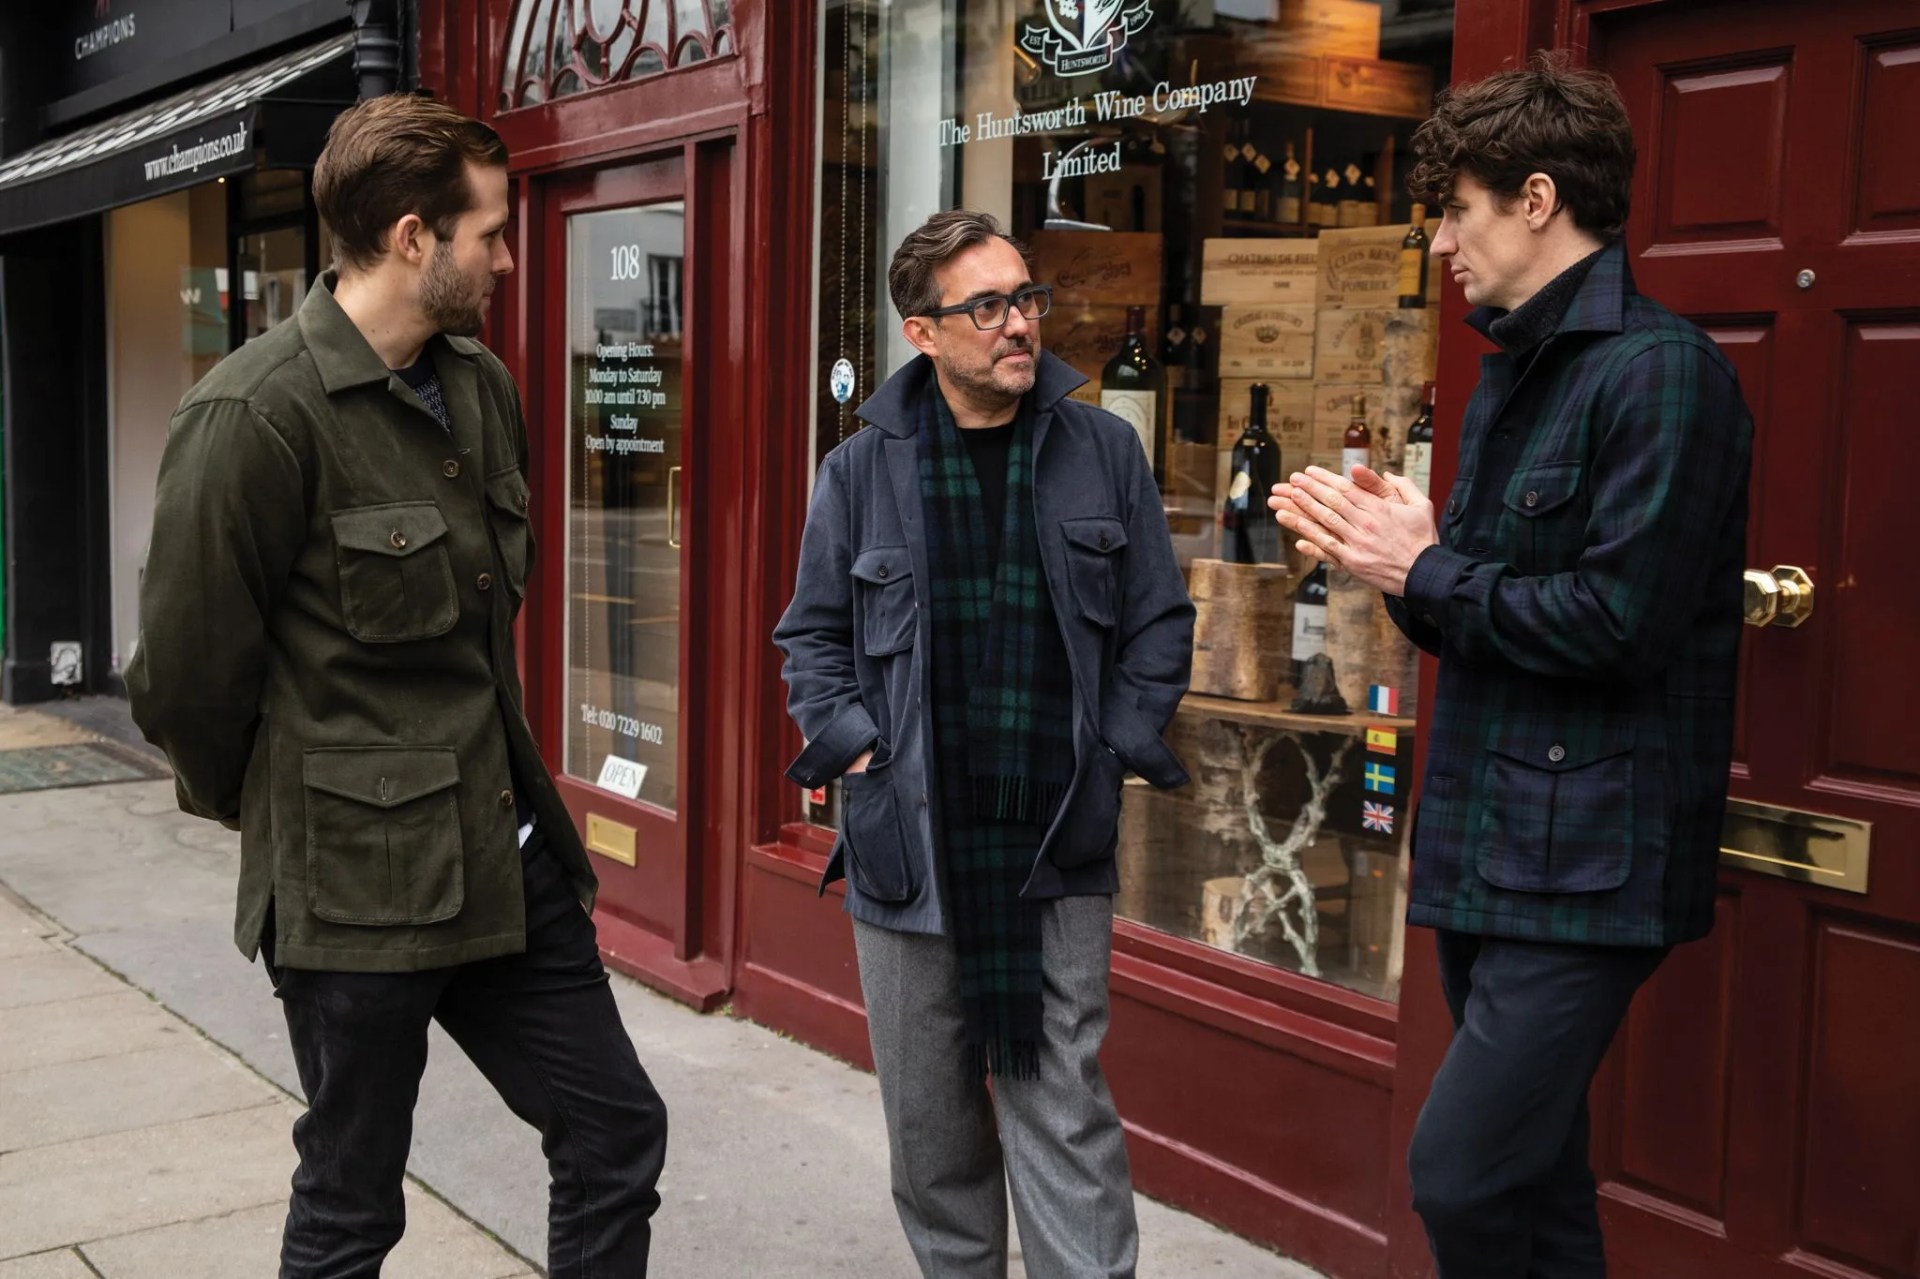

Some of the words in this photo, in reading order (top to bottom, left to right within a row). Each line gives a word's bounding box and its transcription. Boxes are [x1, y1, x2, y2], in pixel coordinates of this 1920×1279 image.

[75, 12, 135, 60] CHAMPIONS
[938, 117, 970, 147] The
[976, 97, 1086, 142] Huntsworth
[1094, 90, 1147, 123] Wine
[1152, 75, 1257, 114] Company
[144, 120, 249, 181] www.champions.co.uk
[1042, 142, 1122, 181] Limited
[610, 244, 640, 280] 108
[596, 341, 628, 362] Opening
[589, 366, 618, 387] Monday
[619, 369, 628, 383] to
[628, 366, 663, 387] Saturday
[603, 391, 616, 404] am
[616, 388, 635, 404] until
[652, 391, 667, 409] pm
[610, 413, 639, 434] Sunday
[585, 434, 605, 453] Open
[605, 434, 616, 455] by
[616, 435, 665, 456] appointment
[599, 709, 617, 731] 020
[617, 714, 640, 738] 7229
[641, 721, 663, 746] 1602
[603, 761, 639, 788] OPEN
